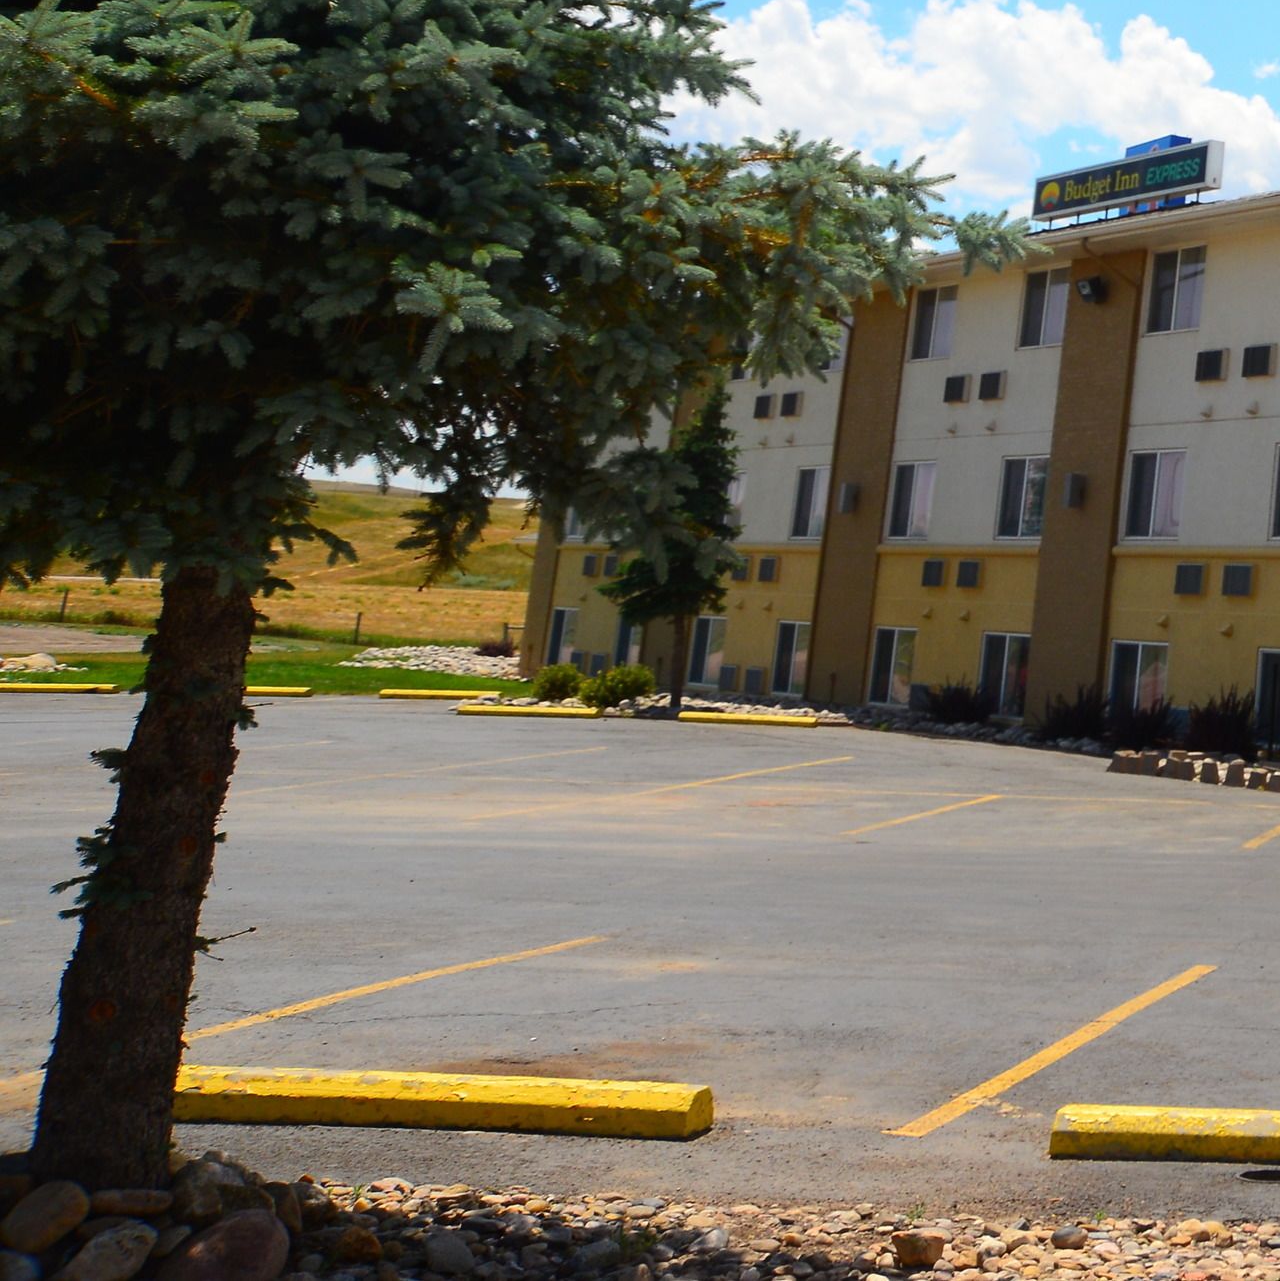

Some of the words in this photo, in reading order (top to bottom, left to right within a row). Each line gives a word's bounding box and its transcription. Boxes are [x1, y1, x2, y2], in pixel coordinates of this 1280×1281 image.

[1064, 176, 1111, 203] Budget
[1115, 170, 1140, 192] Inn
[1145, 158, 1201, 185] EXPRESS
